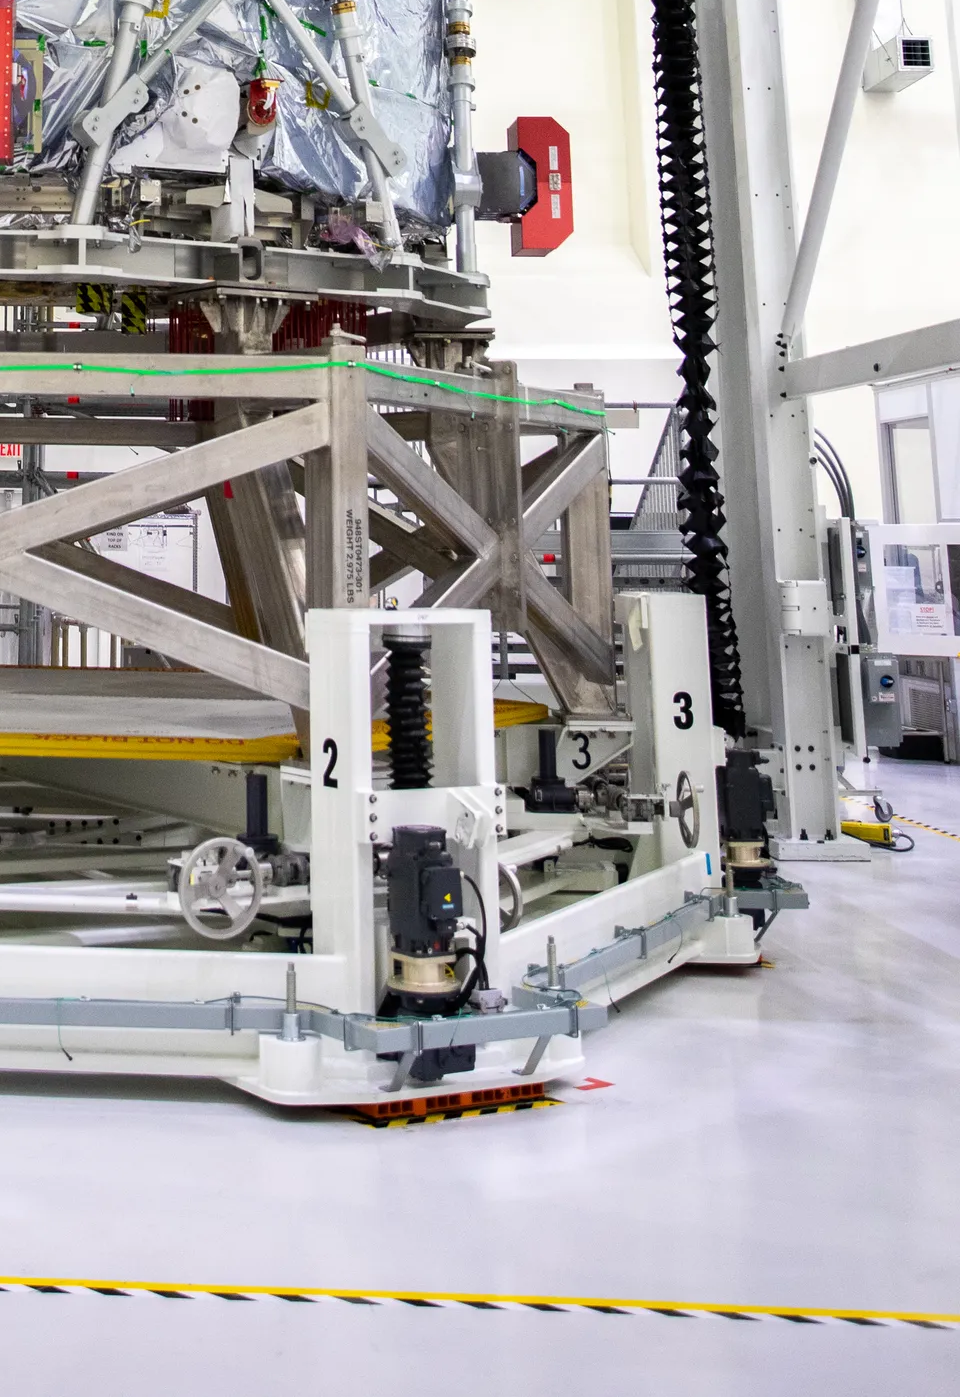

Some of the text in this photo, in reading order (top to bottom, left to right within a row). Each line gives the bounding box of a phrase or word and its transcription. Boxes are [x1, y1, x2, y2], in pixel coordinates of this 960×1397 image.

[0, 443, 21, 457] EXIT
[345, 508, 354, 550] WEIGHT
[354, 518, 363, 594] 948ST0473-301
[346, 582, 355, 604] LBS
[673, 691, 694, 730] 3
[322, 737, 338, 789] 2
[571, 732, 592, 770] 3
